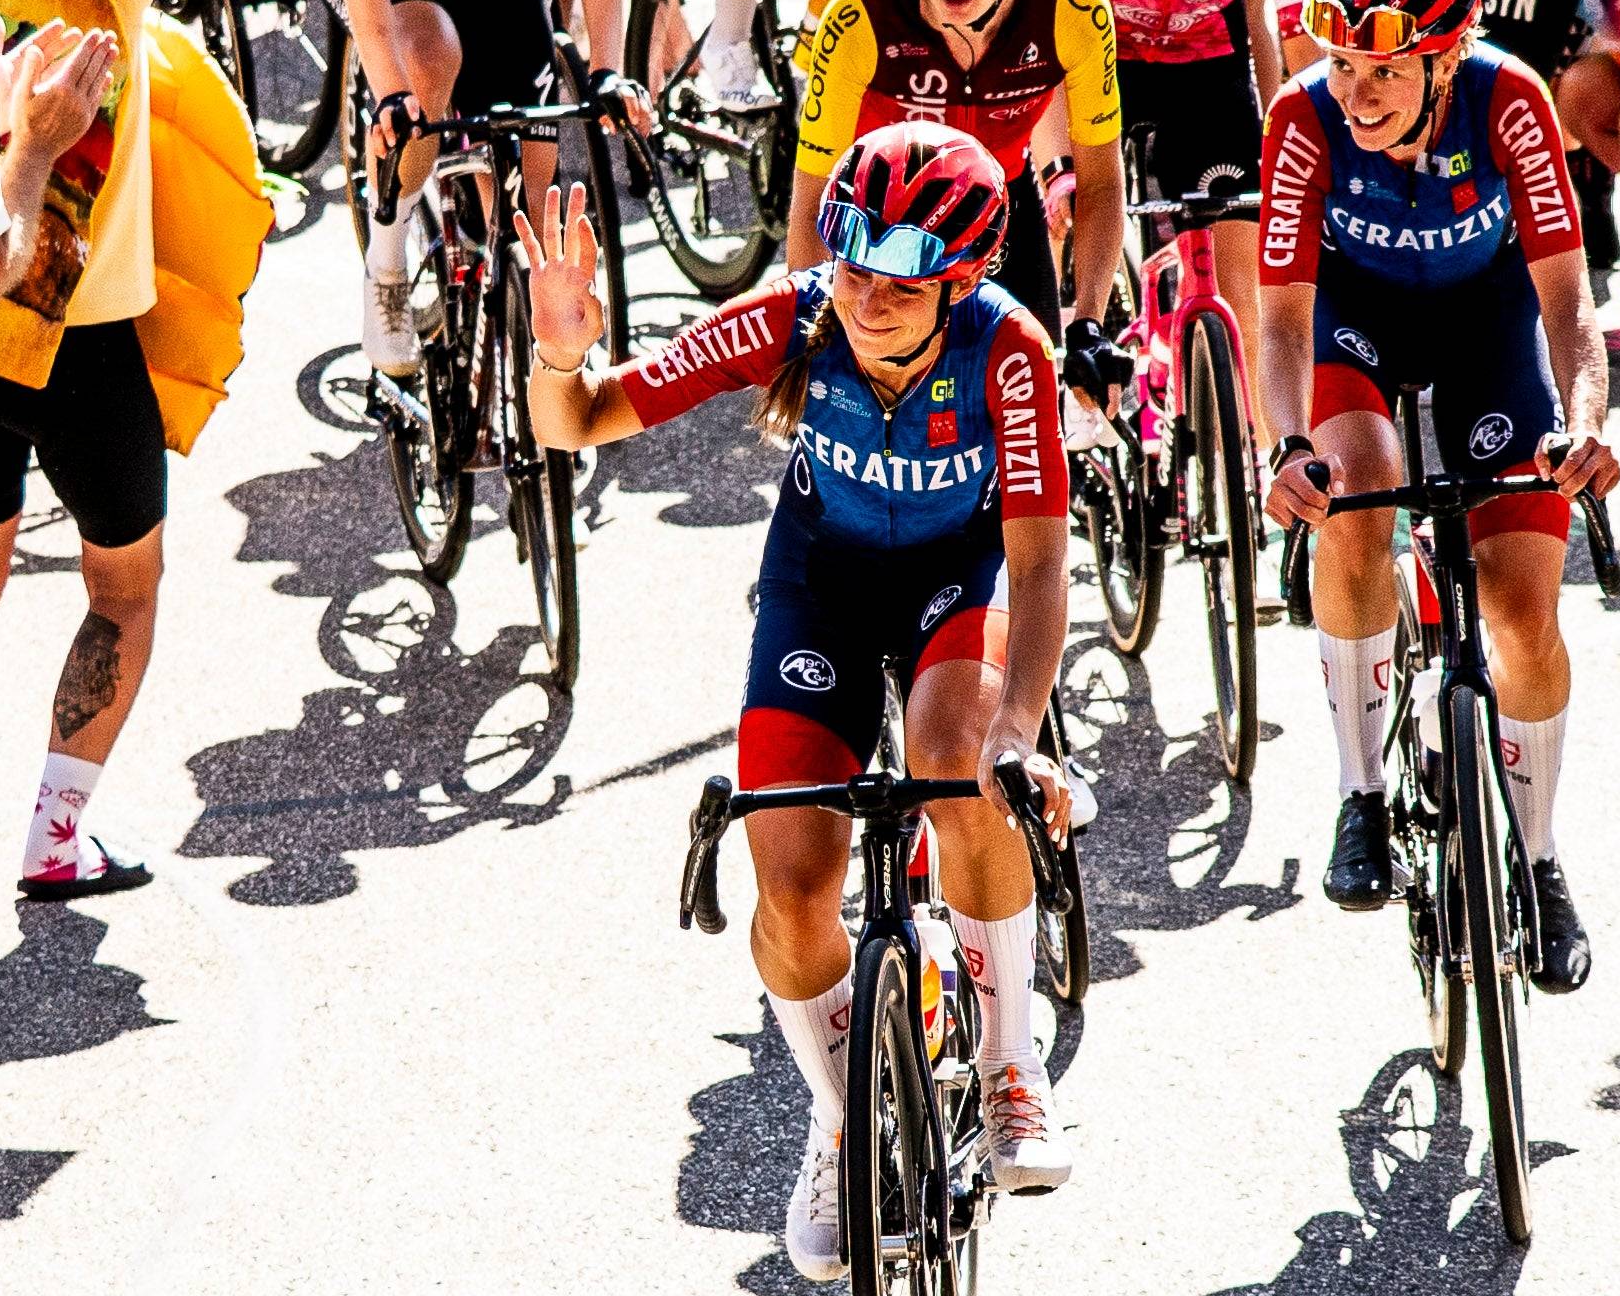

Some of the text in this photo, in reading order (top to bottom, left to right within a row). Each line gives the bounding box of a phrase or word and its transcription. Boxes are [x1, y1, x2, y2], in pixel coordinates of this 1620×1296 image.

[804, 3, 862, 124] Cofidis
[1264, 121, 1321, 268] CERATIZIT
[1497, 97, 1572, 236] CERATIZIT
[1330, 194, 1506, 252] CERATIZIT
[636, 306, 776, 389] CERATIZIT
[797, 422, 985, 493] CERATIZIT
[1454, 581, 1464, 643] ORBEA
[882, 842, 892, 911] ORBEA
